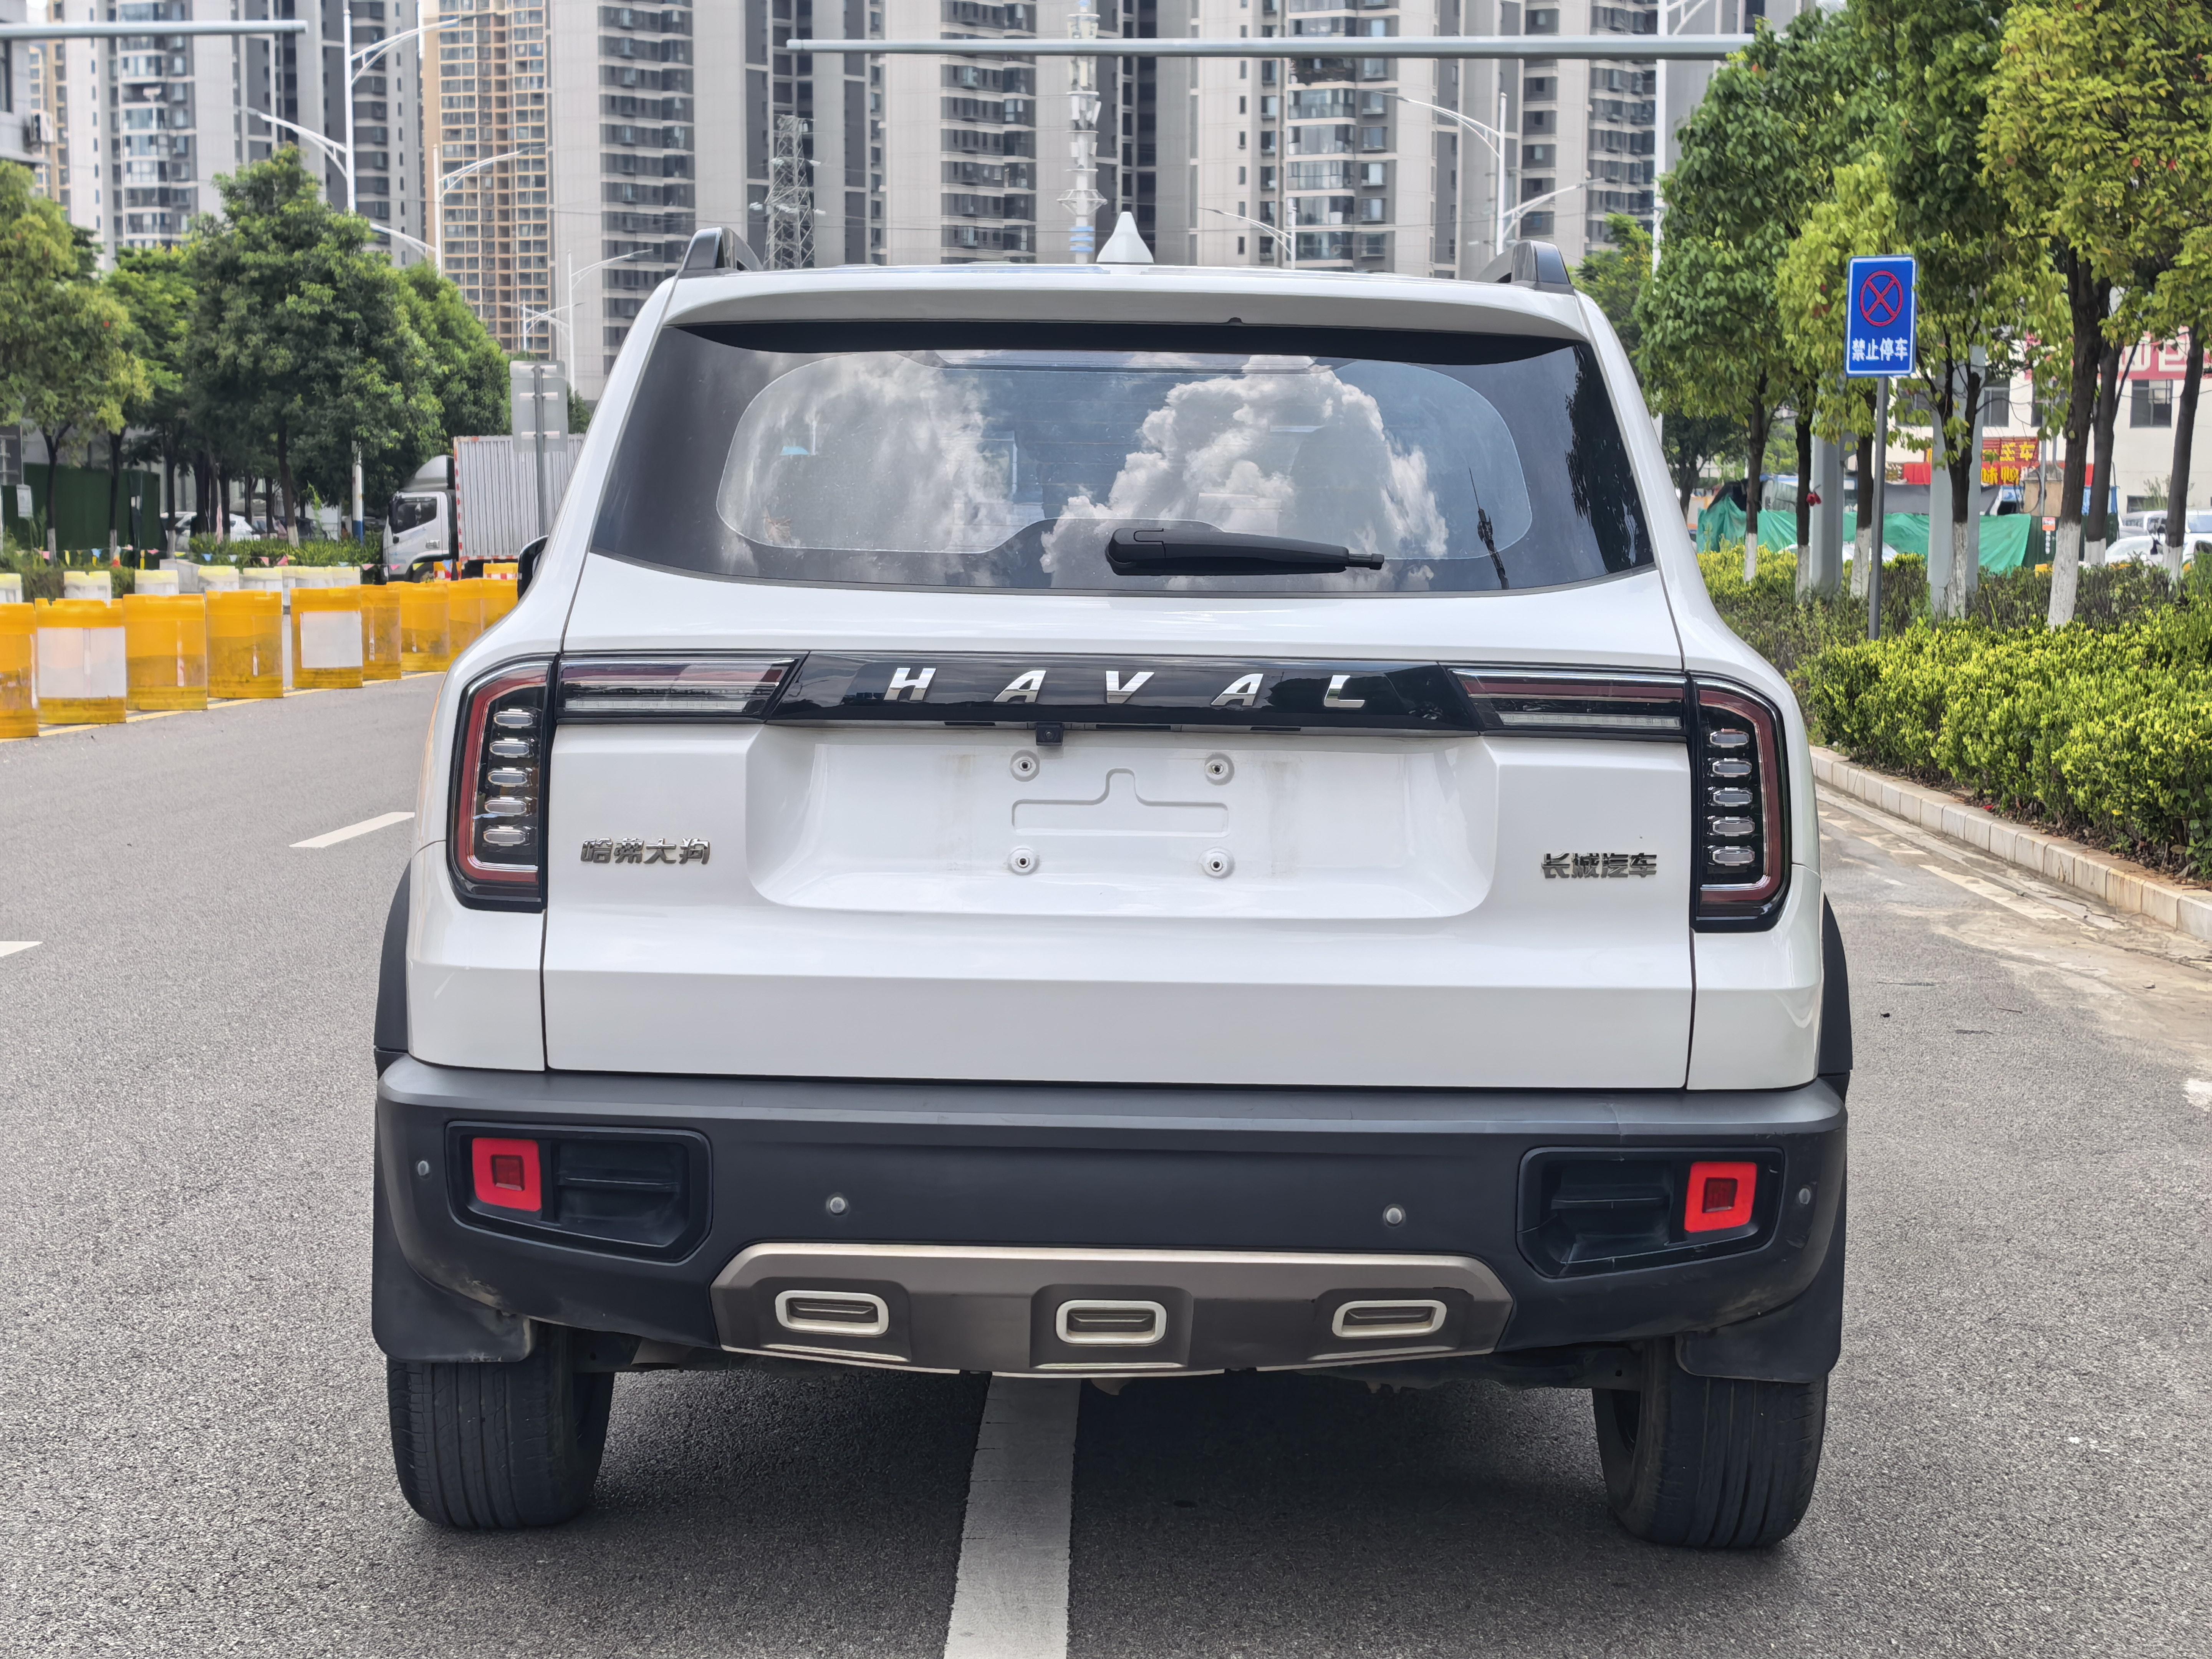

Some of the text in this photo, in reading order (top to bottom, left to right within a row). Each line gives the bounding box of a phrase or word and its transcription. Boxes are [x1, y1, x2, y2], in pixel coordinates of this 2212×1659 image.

[1852, 338, 1908, 361] 禁止停车
[883, 667, 1365, 708] HAVAL
[1541, 853, 1657, 878] 长城汽车
